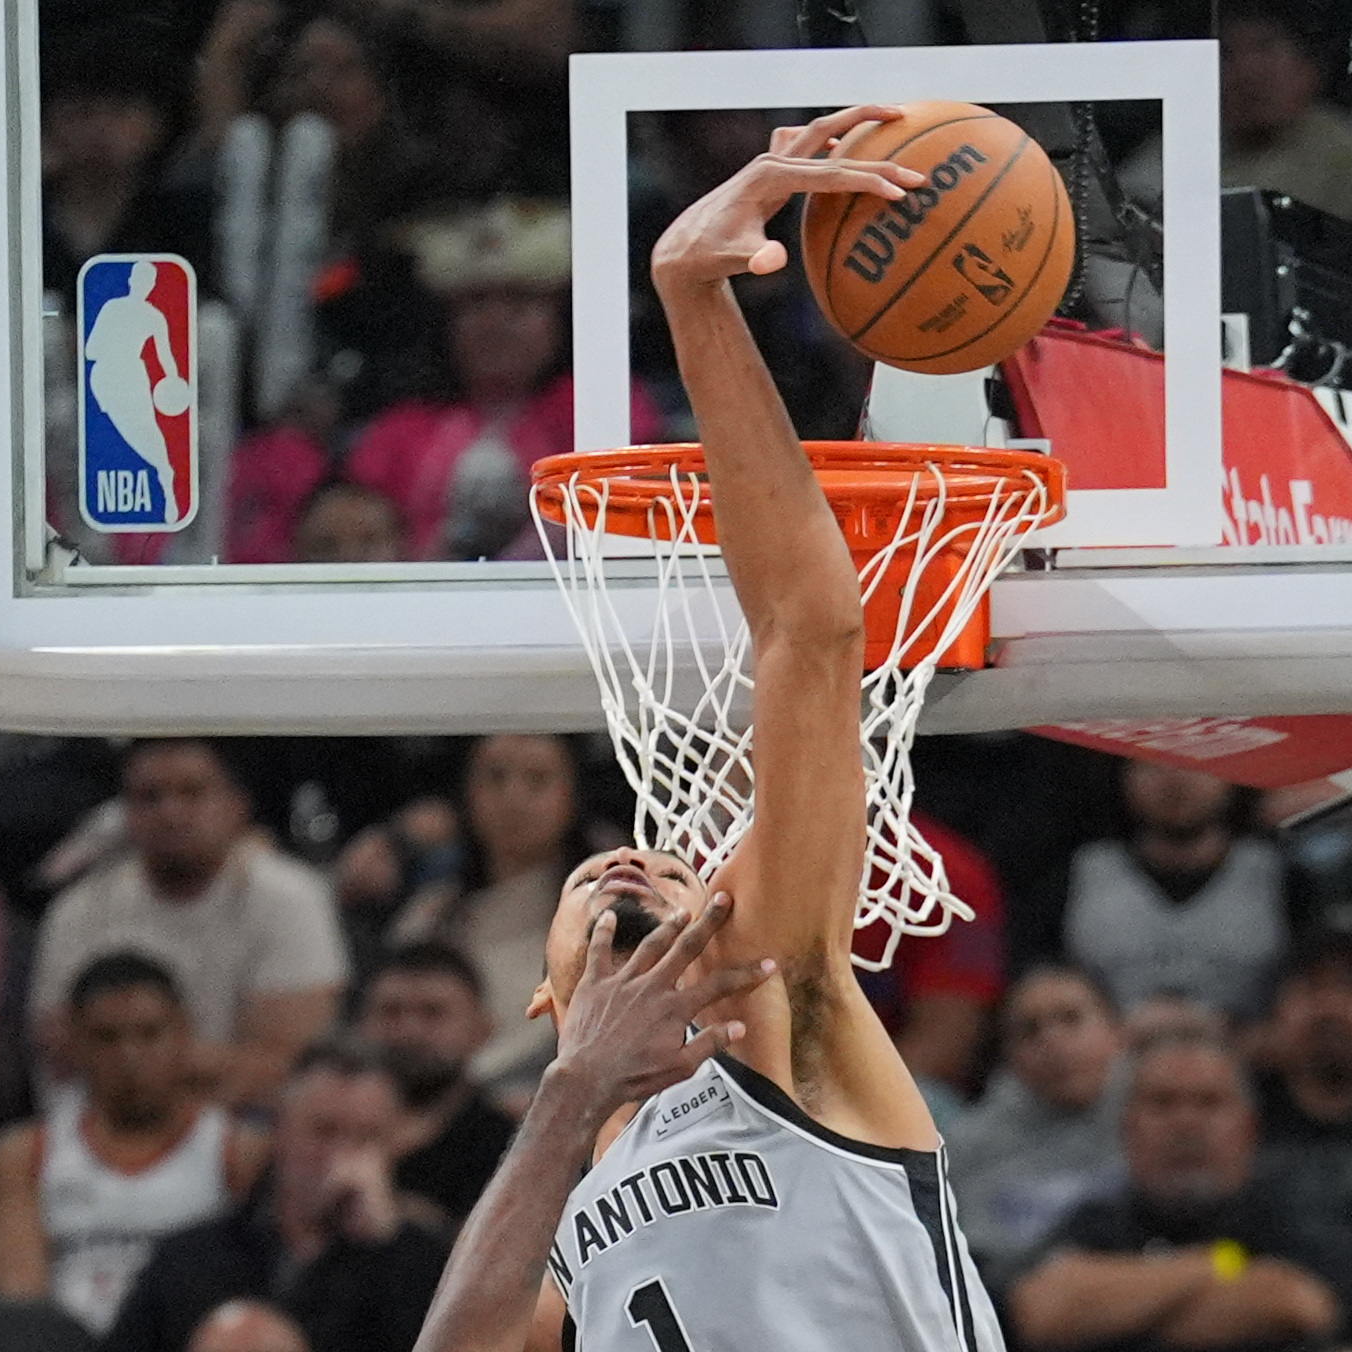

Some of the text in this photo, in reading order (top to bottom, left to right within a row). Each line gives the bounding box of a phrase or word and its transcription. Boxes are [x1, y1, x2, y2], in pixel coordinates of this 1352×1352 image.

[843, 143, 988, 284] Wilson
[97, 469, 152, 513] NBA
[662, 1086, 718, 1125] LEDGER
[572, 1151, 780, 1269] ANTONIO
